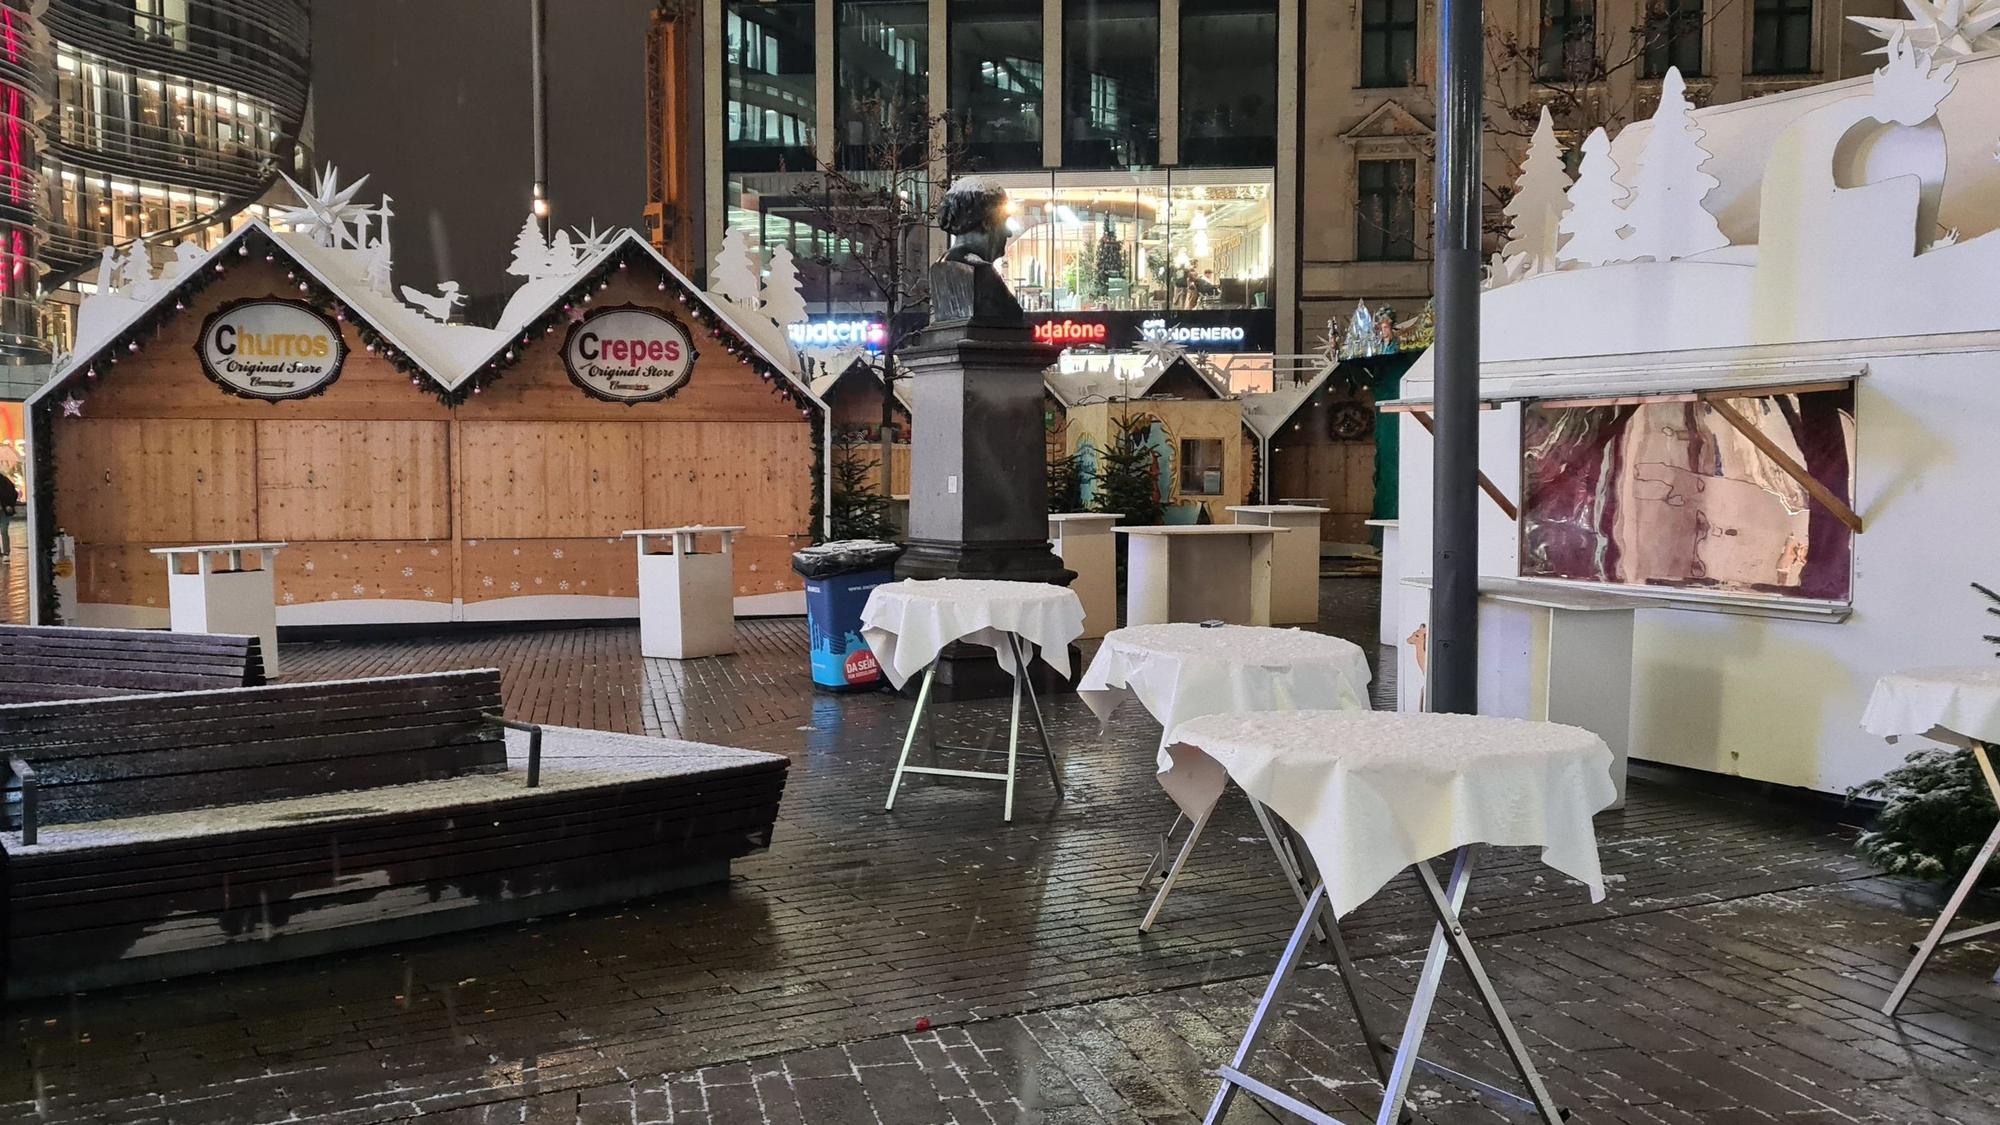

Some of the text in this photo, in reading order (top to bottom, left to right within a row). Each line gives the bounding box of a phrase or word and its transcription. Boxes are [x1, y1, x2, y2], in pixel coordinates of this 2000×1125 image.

[215, 324, 328, 357] Churros
[579, 332, 680, 367] Crepes
[226, 359, 285, 377] Original
[588, 365, 674, 380] Original Store
